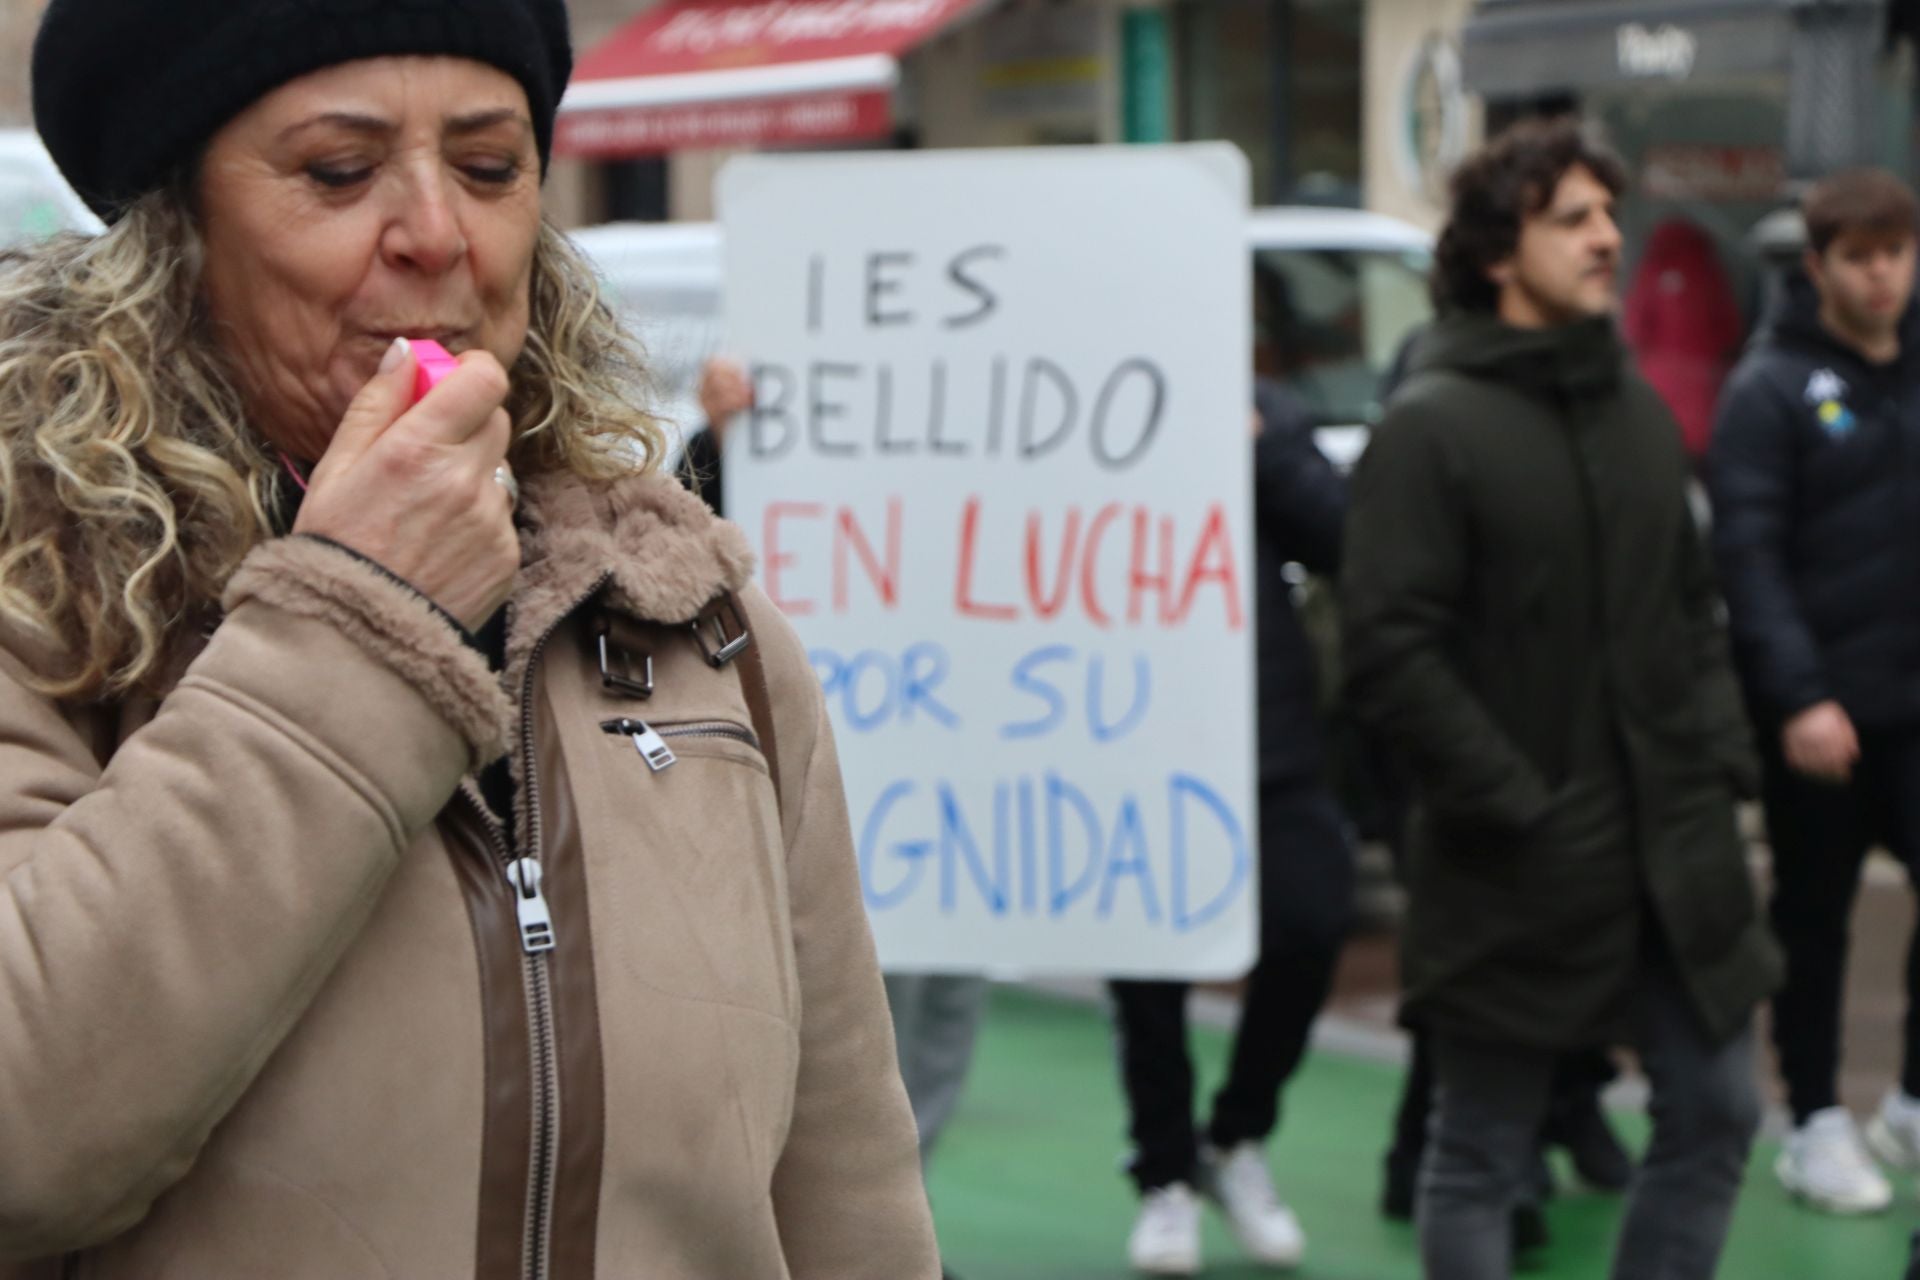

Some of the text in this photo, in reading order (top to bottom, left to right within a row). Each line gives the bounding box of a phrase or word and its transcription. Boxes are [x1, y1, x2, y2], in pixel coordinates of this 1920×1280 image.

[805, 243, 1008, 333] IES
[748, 355, 1167, 470] BELLIDO
[763, 494, 1245, 632] EN LUCHA
[1000, 643, 1152, 742] SU
[860, 771, 1248, 933] GNIDAD
